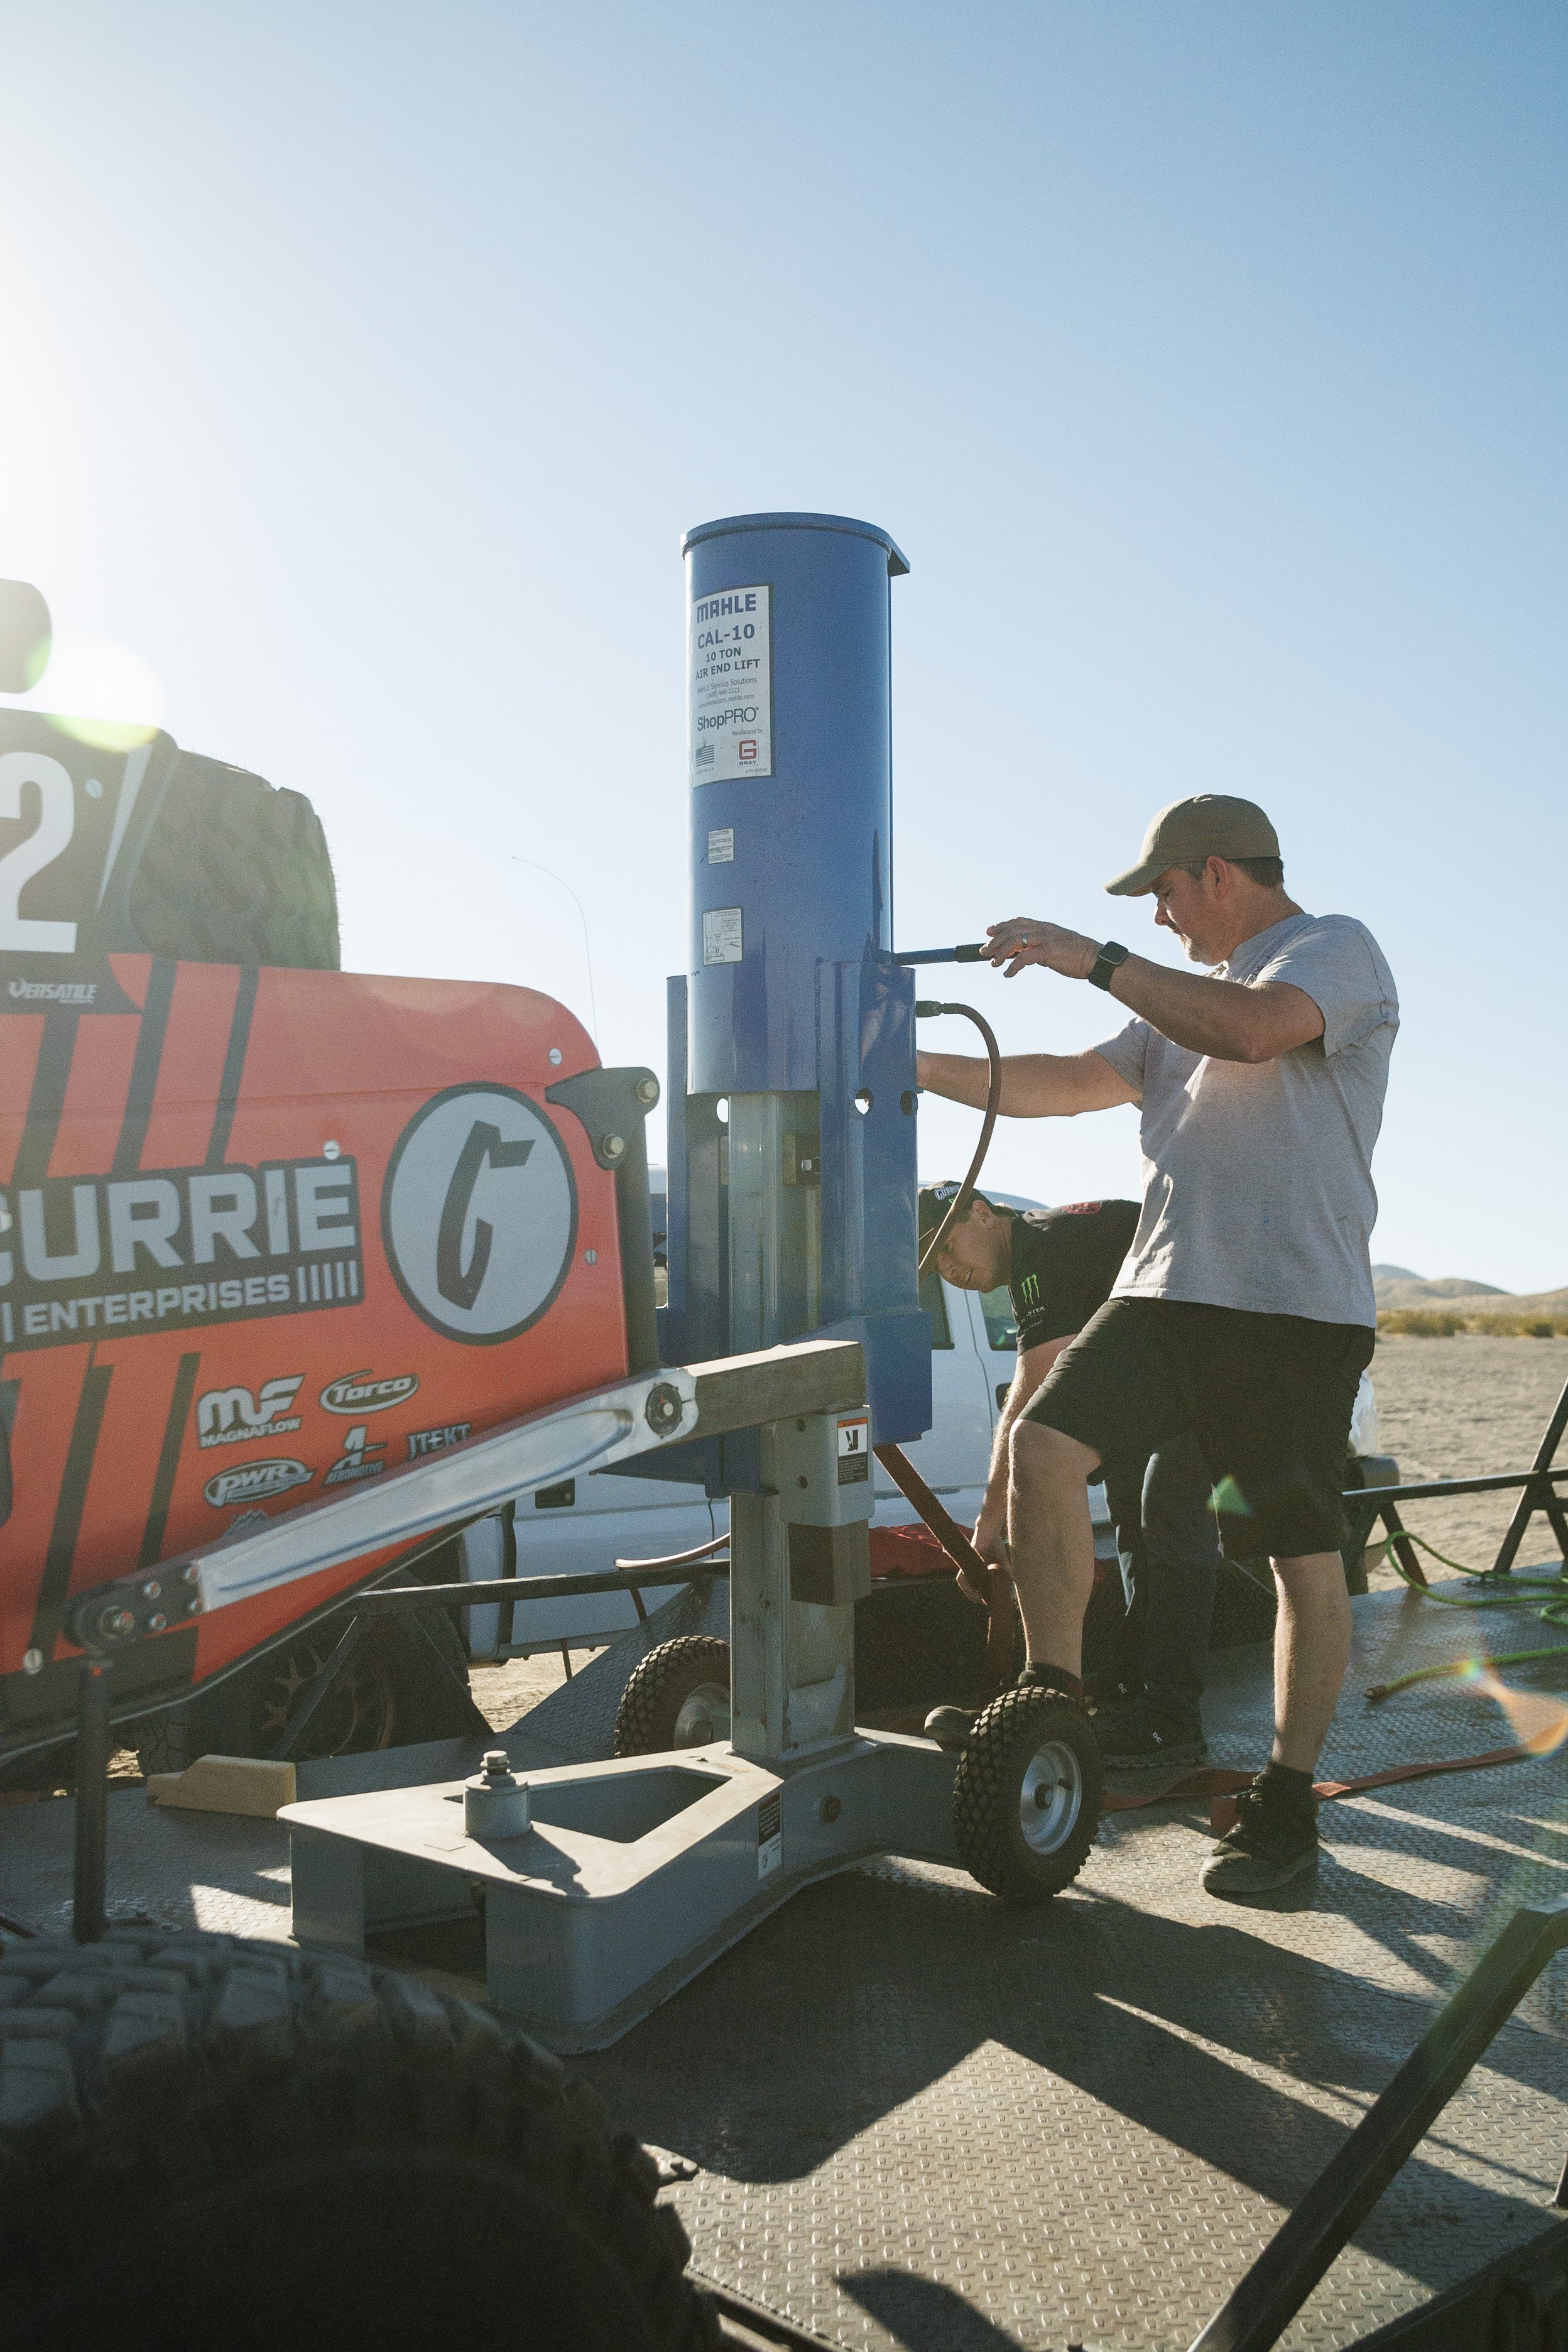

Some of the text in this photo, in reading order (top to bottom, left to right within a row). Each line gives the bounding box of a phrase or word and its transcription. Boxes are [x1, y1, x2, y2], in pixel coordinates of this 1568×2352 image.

[697, 593, 756, 624] MAHLE
[697, 623, 755, 650] CAL-10
[695, 658, 760, 680] AIR END LIFT
[705, 646, 741, 663] 10 TON
[710, 679, 729, 690] Service
[730, 677, 758, 686] Solutions
[0, 751, 78, 953] 2
[0, 1163, 357, 1287] URRIE
[24, 1273, 291, 1336] ENTERPRISES
[334, 1378, 412, 1403] Torco
[201, 1417, 302, 1448] MAGNAFLOW
[216, 1464, 289, 1503] PWR
